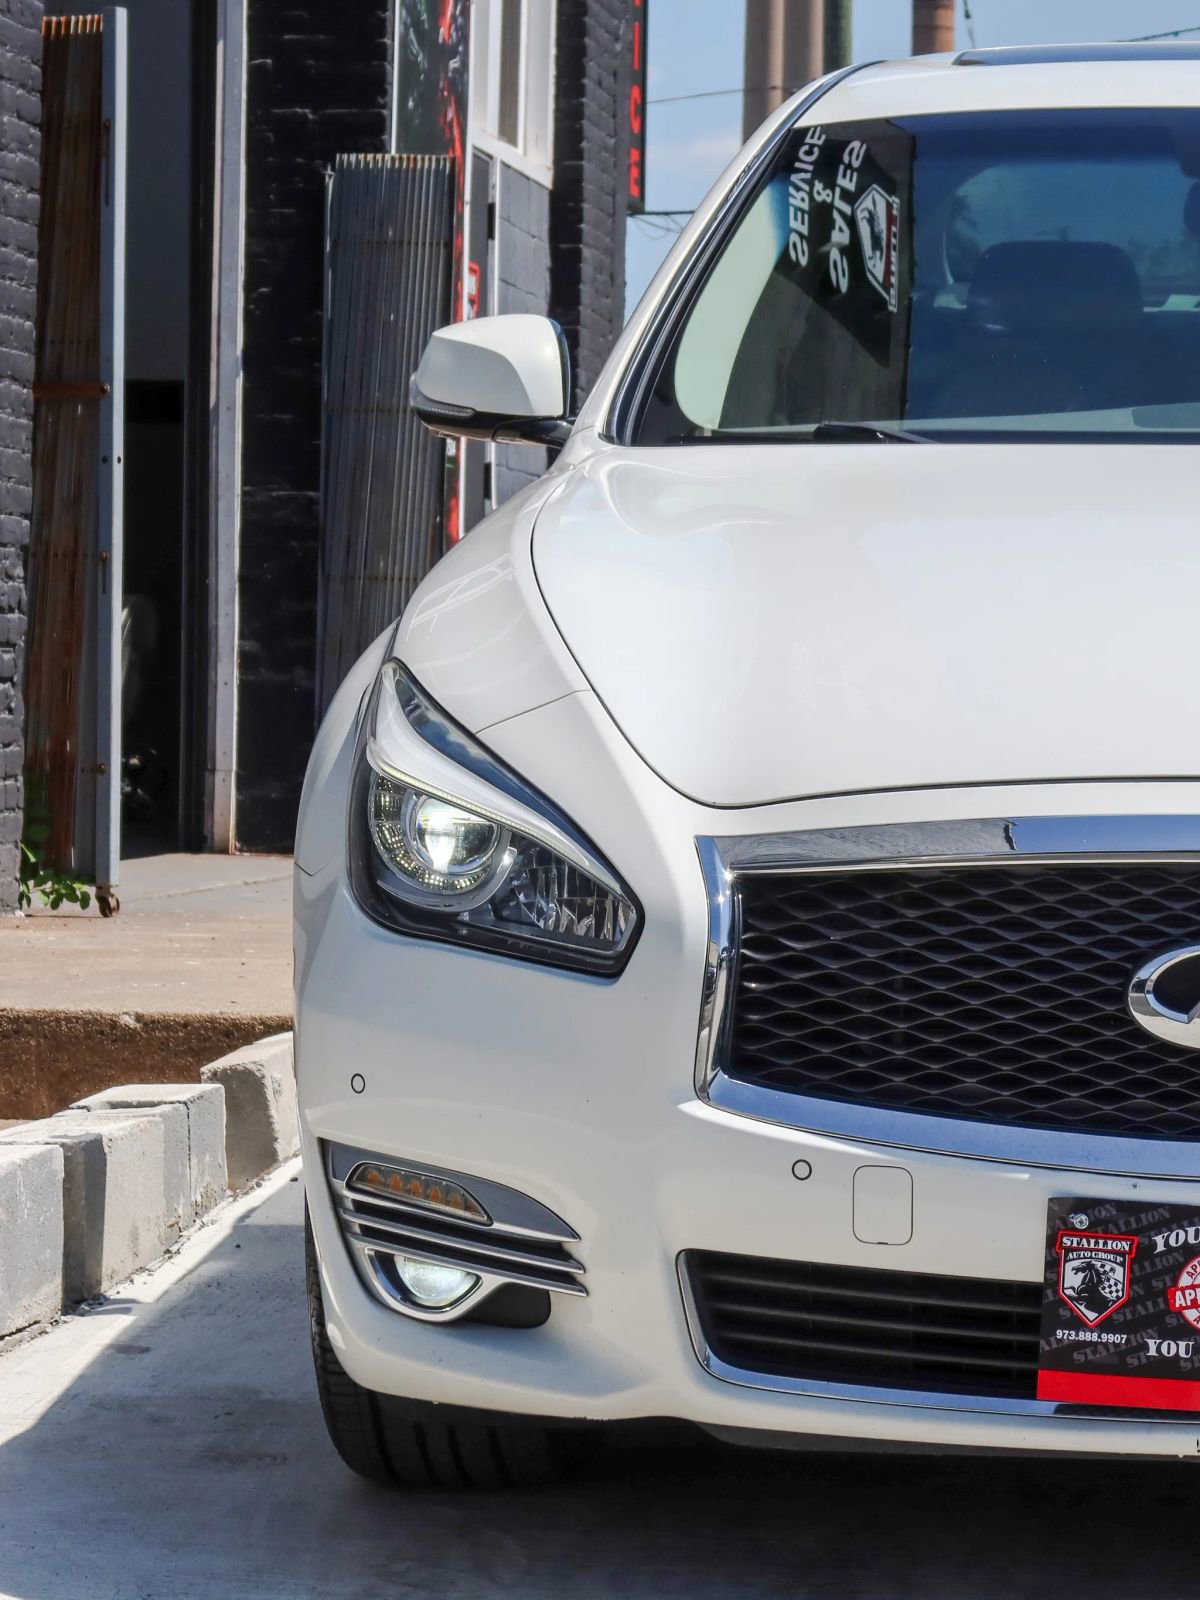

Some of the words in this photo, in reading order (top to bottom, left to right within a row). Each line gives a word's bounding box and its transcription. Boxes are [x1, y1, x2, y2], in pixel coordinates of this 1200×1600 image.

[629, 0, 641, 197] ICE
[1062, 1236, 1131, 1251] STALLION
[1067, 1251, 1091, 1260] AUTO
[1056, 1330, 1127, 1344] 973.888.9907
[1144, 1338, 1195, 1358] YOU
